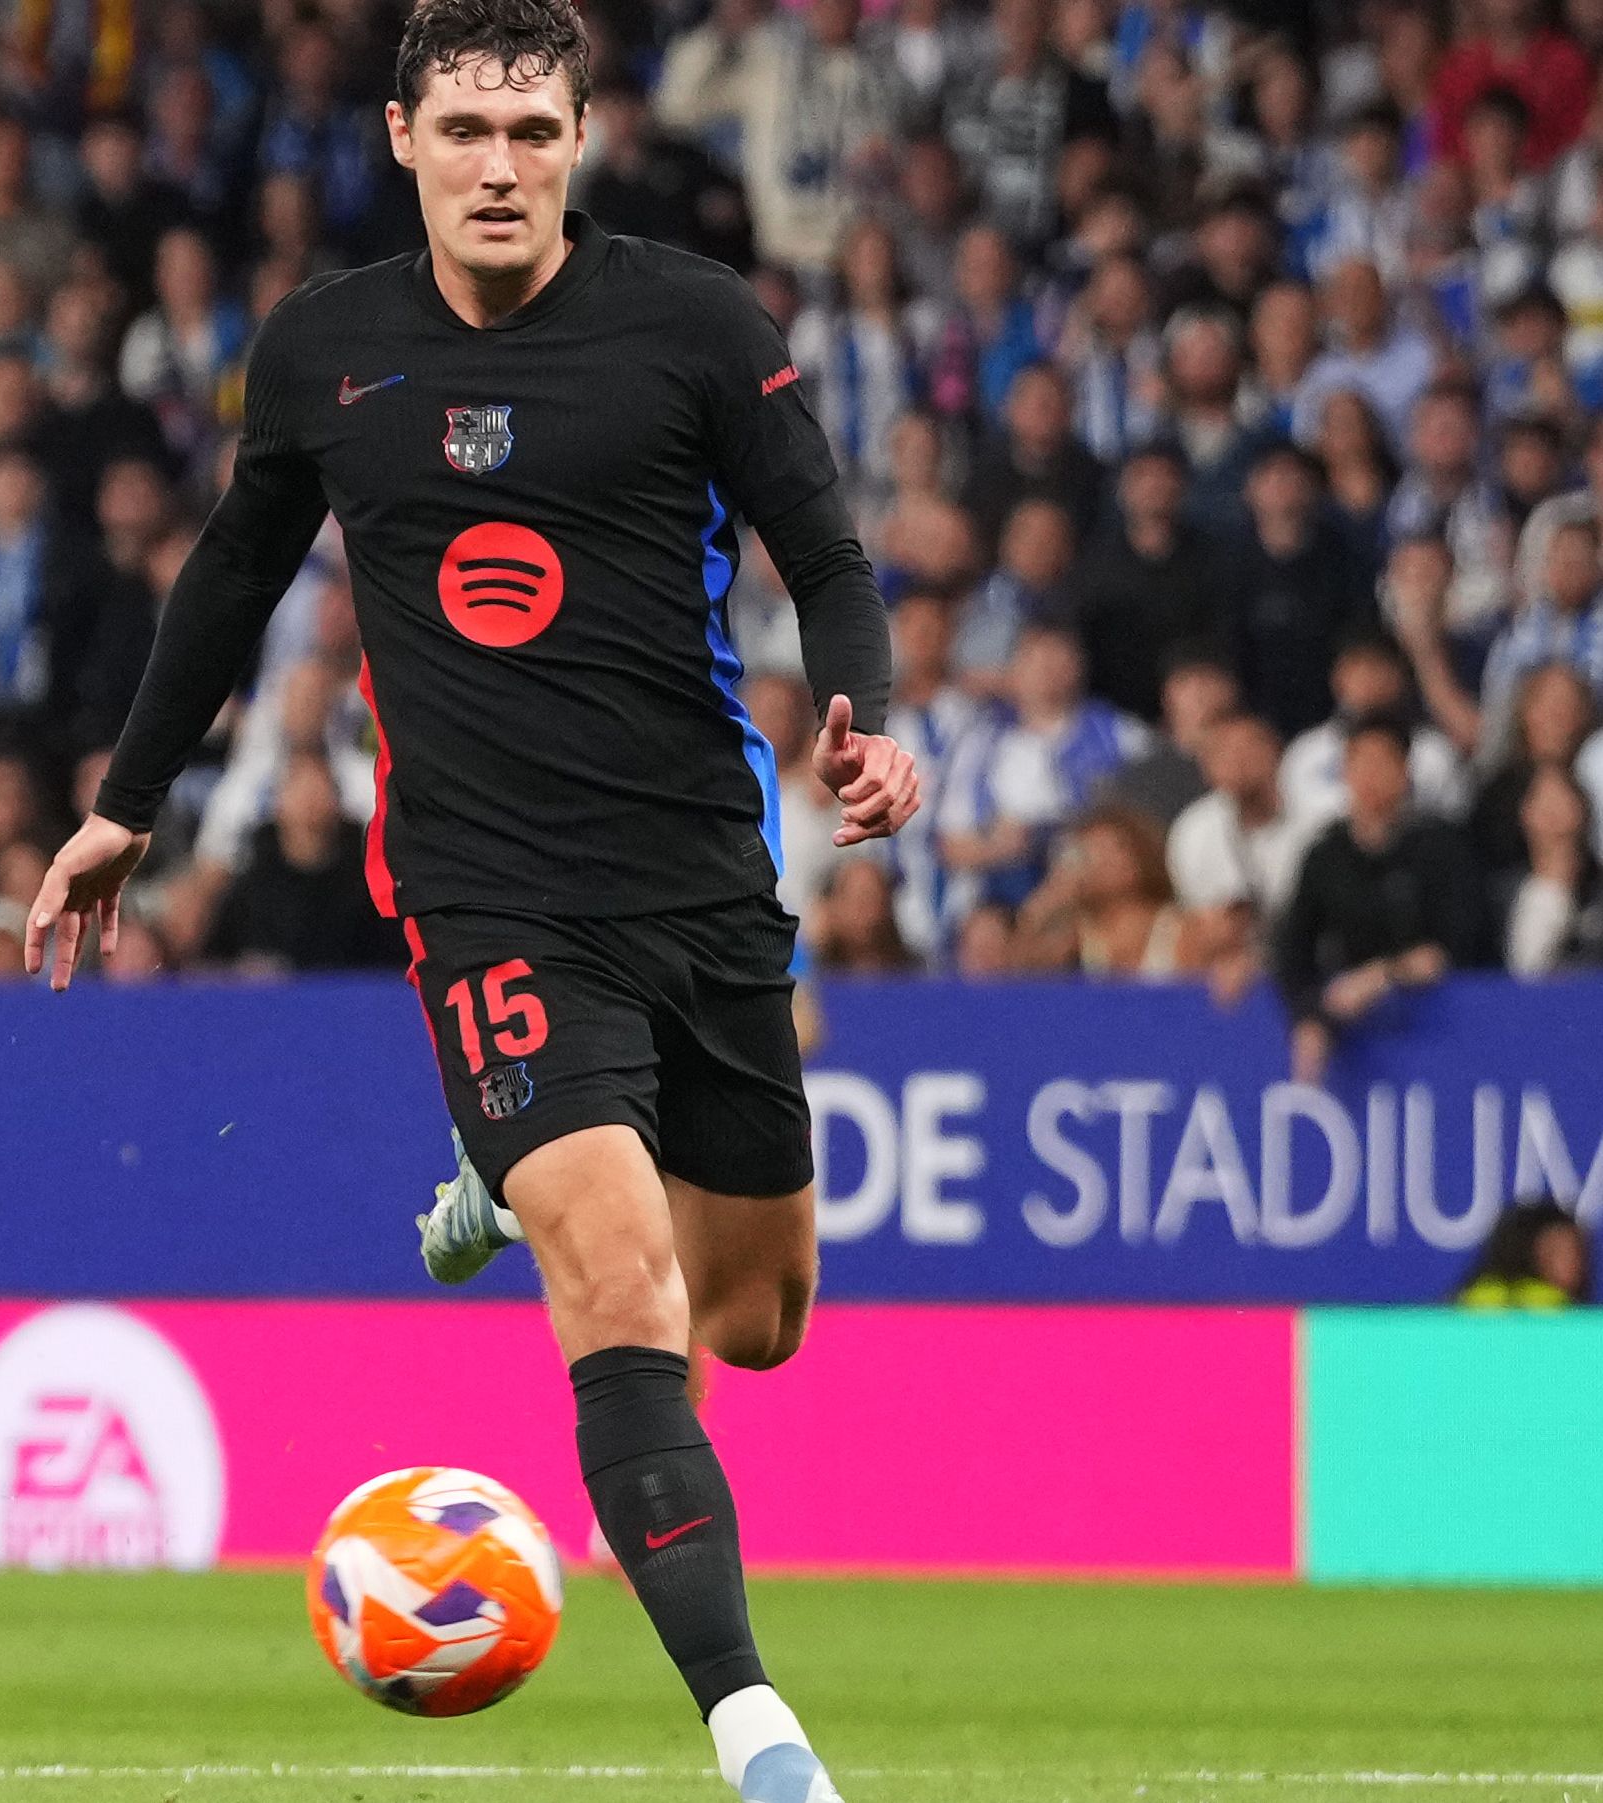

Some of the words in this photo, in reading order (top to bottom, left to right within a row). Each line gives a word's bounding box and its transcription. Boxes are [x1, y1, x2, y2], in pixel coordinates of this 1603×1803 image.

[444, 958, 548, 1075] 15
[802, 1072, 989, 1246] DE
[12, 1394, 159, 1499] EA
